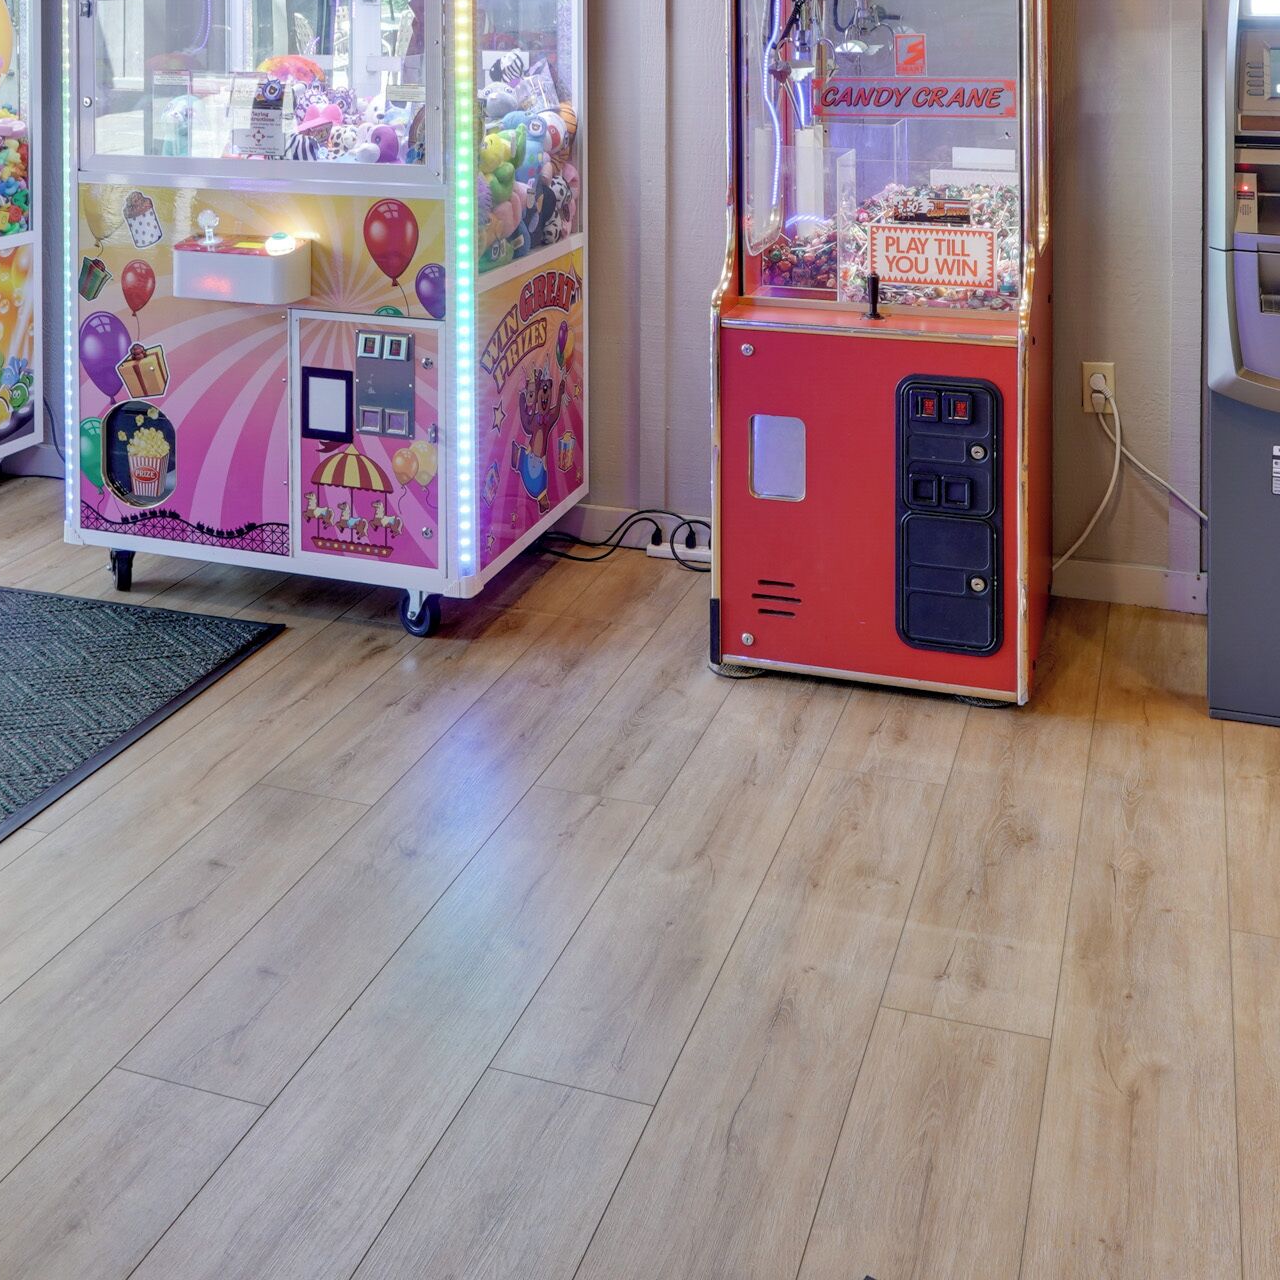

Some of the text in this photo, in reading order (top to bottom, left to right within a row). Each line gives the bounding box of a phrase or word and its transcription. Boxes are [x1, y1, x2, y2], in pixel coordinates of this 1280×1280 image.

[821, 86, 1005, 108] CANDY CRANE
[885, 236, 971, 257] PLAY TILL
[885, 255, 978, 277] YOU WIN
[520, 271, 576, 324] GREAT
[480, 304, 519, 375] WIN
[493, 317, 547, 394] PRIZES
[135, 469, 156, 479] PRIZE
